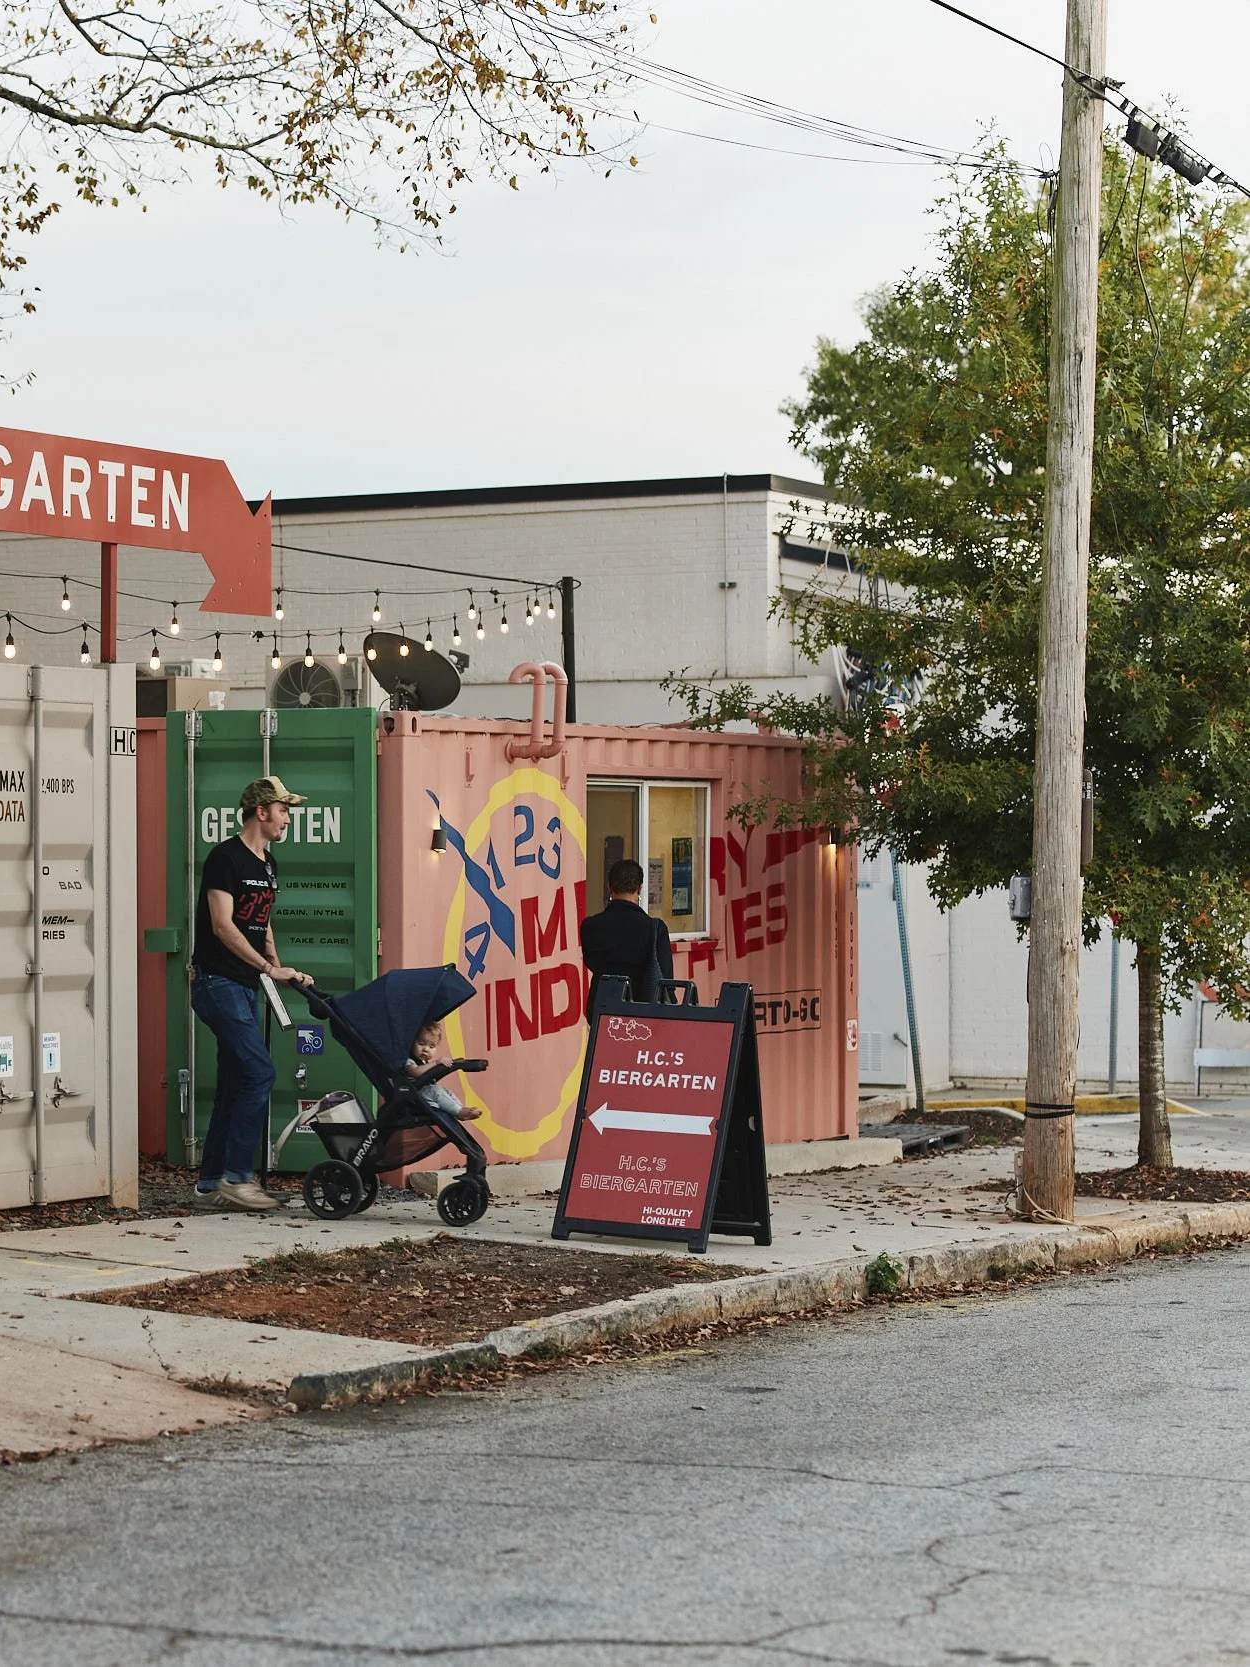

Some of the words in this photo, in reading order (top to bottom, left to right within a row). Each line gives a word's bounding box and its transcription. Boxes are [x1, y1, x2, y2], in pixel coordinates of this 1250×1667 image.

[0, 770, 25, 792] MAX
[62, 779, 74, 794] BPS
[201, 806, 341, 843] GETEN
[514, 805, 535, 867] 2
[486, 837, 506, 890] 1
[58, 881, 82, 890] BAD
[42, 930, 65, 940] RIES
[636, 1050, 684, 1066] H.C.'S
[598, 1069, 716, 1091] BIERGARTEN
[353, 1128, 379, 1166] BRAVO
[618, 1155, 667, 1171] H.C.'S
[580, 1173, 699, 1197] BIERGARTEN
[642, 1206, 693, 1217] HI-QUALITY
[641, 1216, 665, 1225] LONG
[667, 1218, 686, 1227] LIFE
